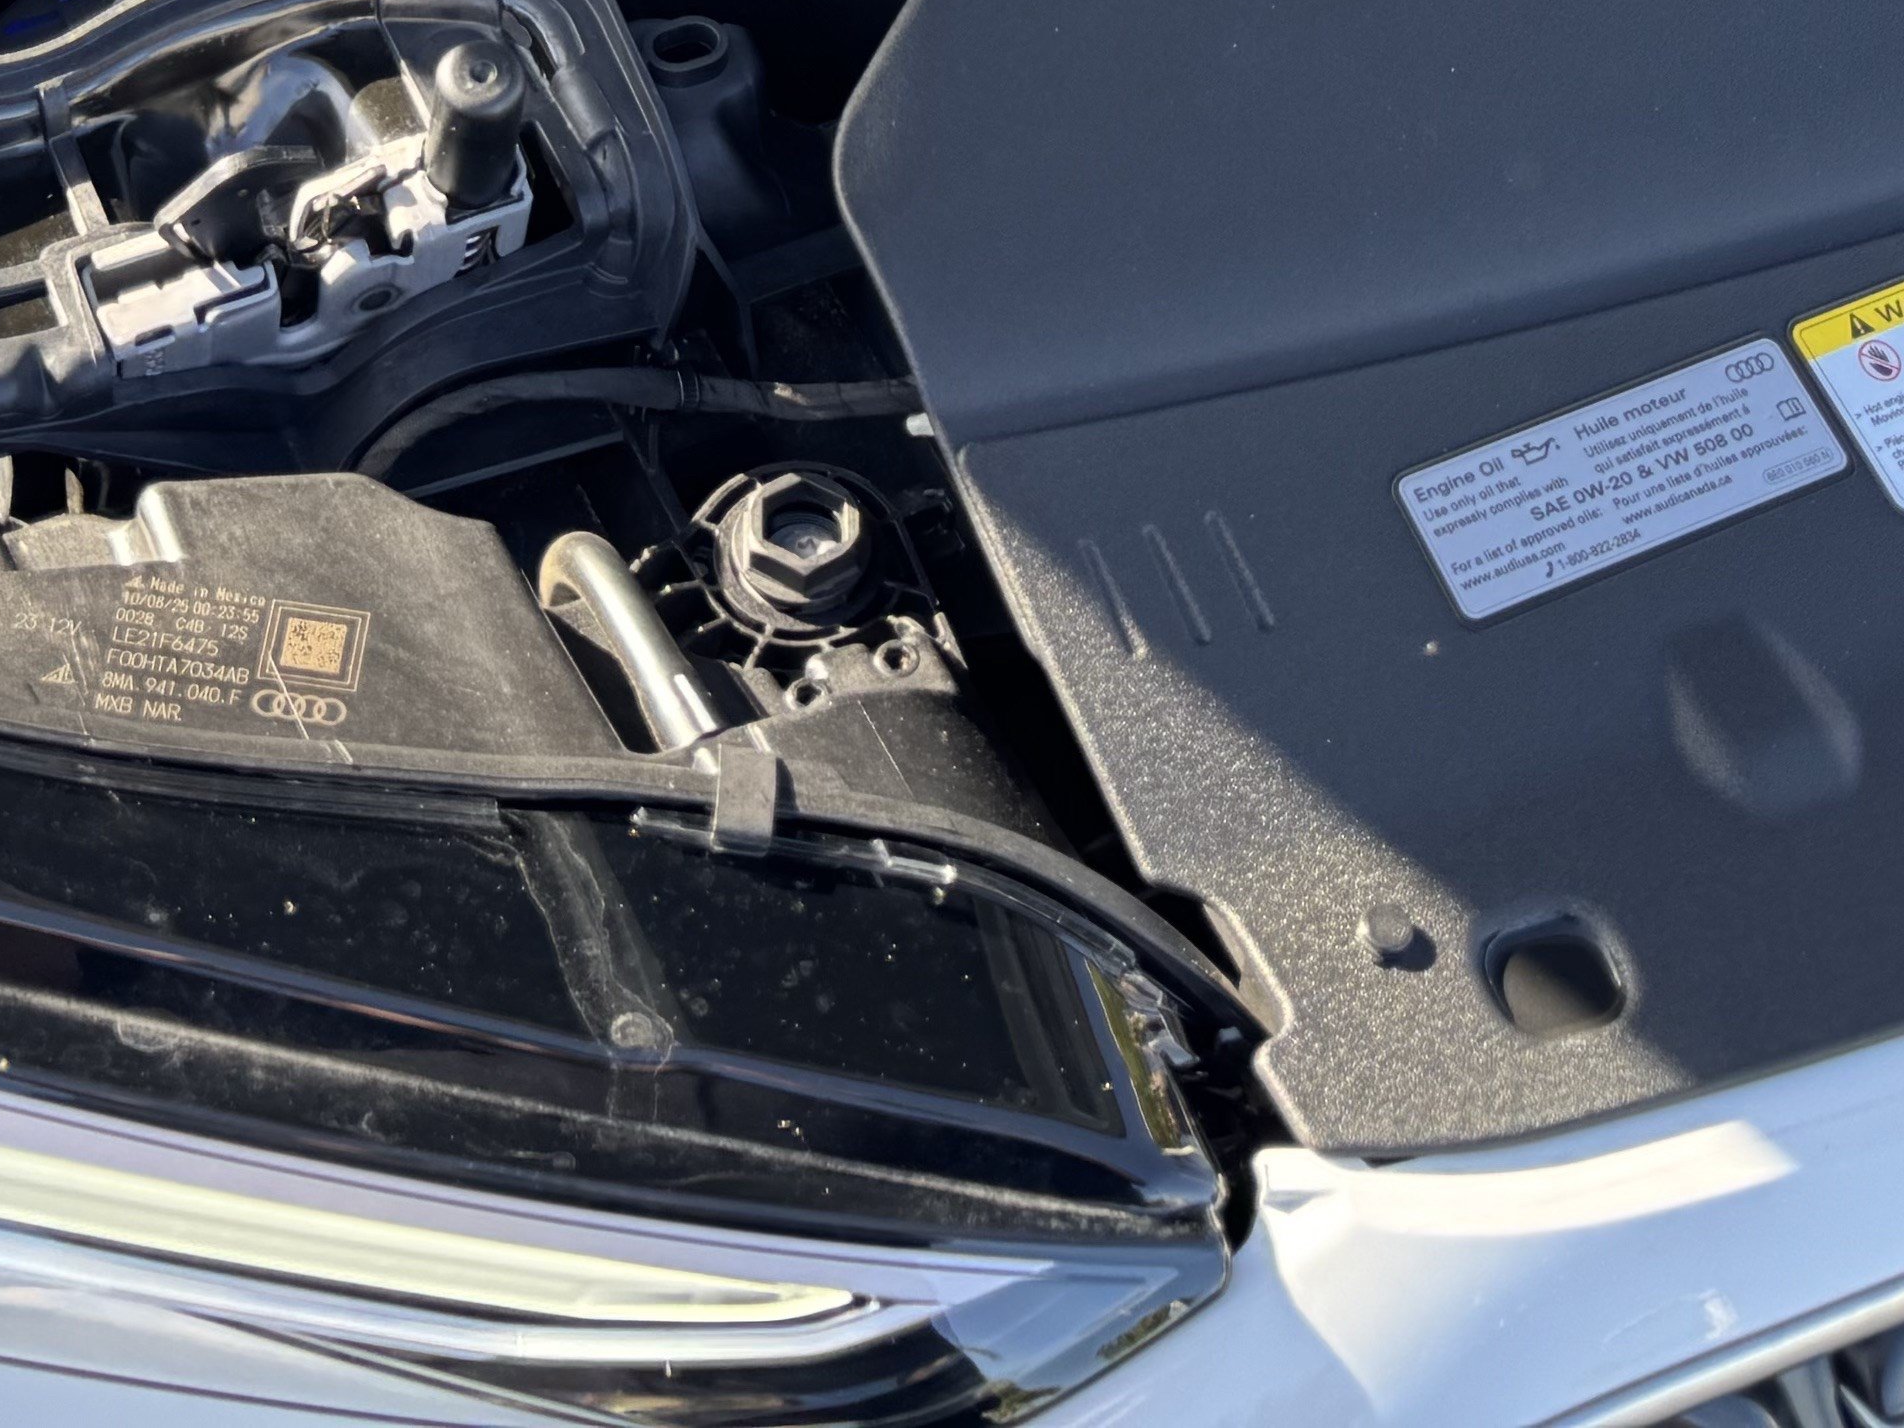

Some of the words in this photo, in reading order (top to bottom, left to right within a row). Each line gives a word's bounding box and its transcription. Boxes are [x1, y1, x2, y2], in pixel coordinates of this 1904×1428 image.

[1574, 413, 1618, 439] Huile
[1623, 389, 1687, 420] moteur
[1585, 434, 1626, 457] Utilisez
[1628, 407, 1696, 441] uniquement
[1695, 399, 1712, 413] de
[1713, 386, 1747, 406] l'huile
[1863, 401, 1882, 415] Hot
[1594, 459, 1614, 474] qui
[1615, 440, 1659, 464] satisfait
[1662, 408, 1740, 446] expressément
[1739, 402, 1751, 414] à
[1414, 469, 1476, 504] Engine
[1478, 456, 1504, 476] Oil
[1531, 496, 1570, 521] SAE
[1573, 471, 1633, 504] 0W-20
[1635, 462, 1654, 479] &
[1656, 448, 1690, 470] VW
[1694, 433, 1727, 455] 508
[1730, 422, 1754, 441] 00
[1613, 490, 1640, 509] Pour
[1643, 482, 1665, 497] une
[1666, 470, 1691, 487] liste
[1693, 451, 1737, 476] d'huiles
[1740, 424, 1807, 459] approuvées:
[1423, 503, 1448, 521] Use
[1450, 494, 1475, 512] only
[1477, 484, 1495, 499] oil
[1495, 474, 1520, 492] that
[1433, 508, 1487, 537] expressly
[1489, 487, 1541, 515] complies
[1542, 475, 1568, 493] with
[1623, 473, 1731, 524] www.audicanada.ca
[1450, 558, 1471, 575] For
[1473, 556, 1483, 566] a
[1483, 545, 1502, 561] list
[1503, 539, 1518, 553] of
[1520, 517, 1575, 548] approved
[1576, 505, 1602, 524] oils:
[1460, 540, 1564, 590] www.audiusa.com
[1558, 528, 1640, 570] 1-800-822-2834
[149, 576, 186, 594] Made
[193, 585, 209, 598] in
[214, 587, 267, 607] Mexico
[93, 691, 134, 714] MXB
